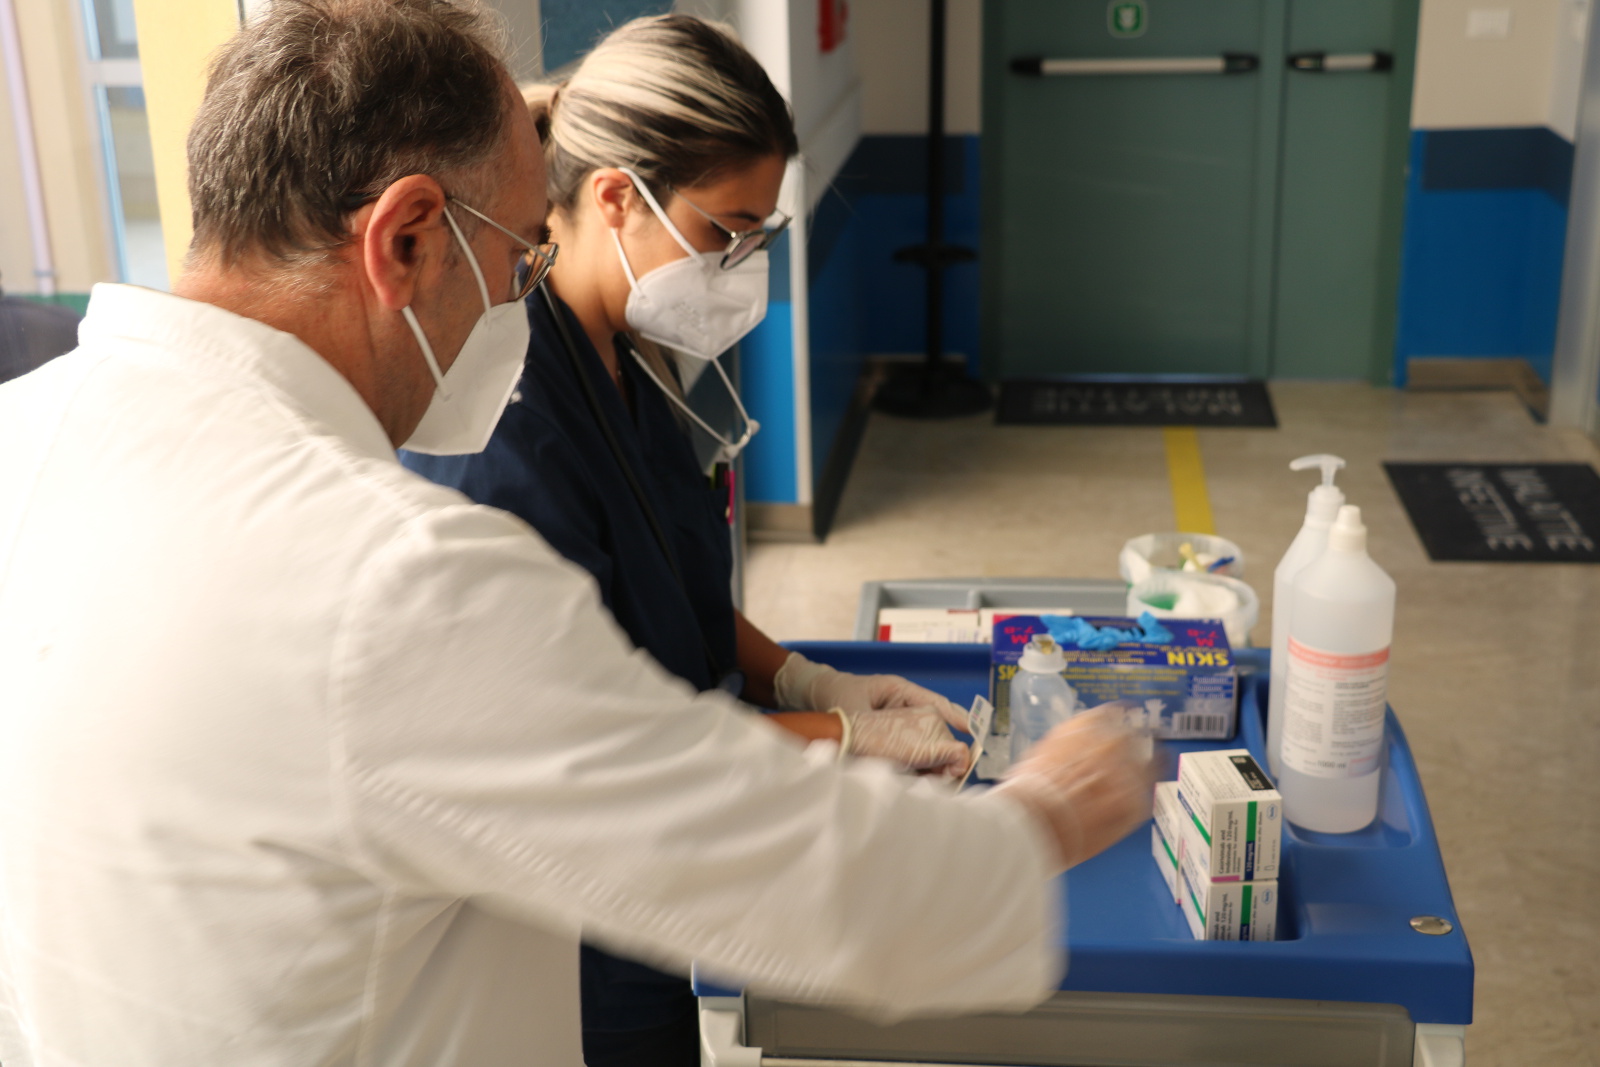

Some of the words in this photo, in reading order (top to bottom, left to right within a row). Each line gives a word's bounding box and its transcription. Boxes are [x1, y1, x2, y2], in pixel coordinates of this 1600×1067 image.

[1011, 634, 1028, 644] M
[1196, 638, 1214, 647] M
[1167, 651, 1229, 666] SKIN
[998, 664, 1022, 680] SK
